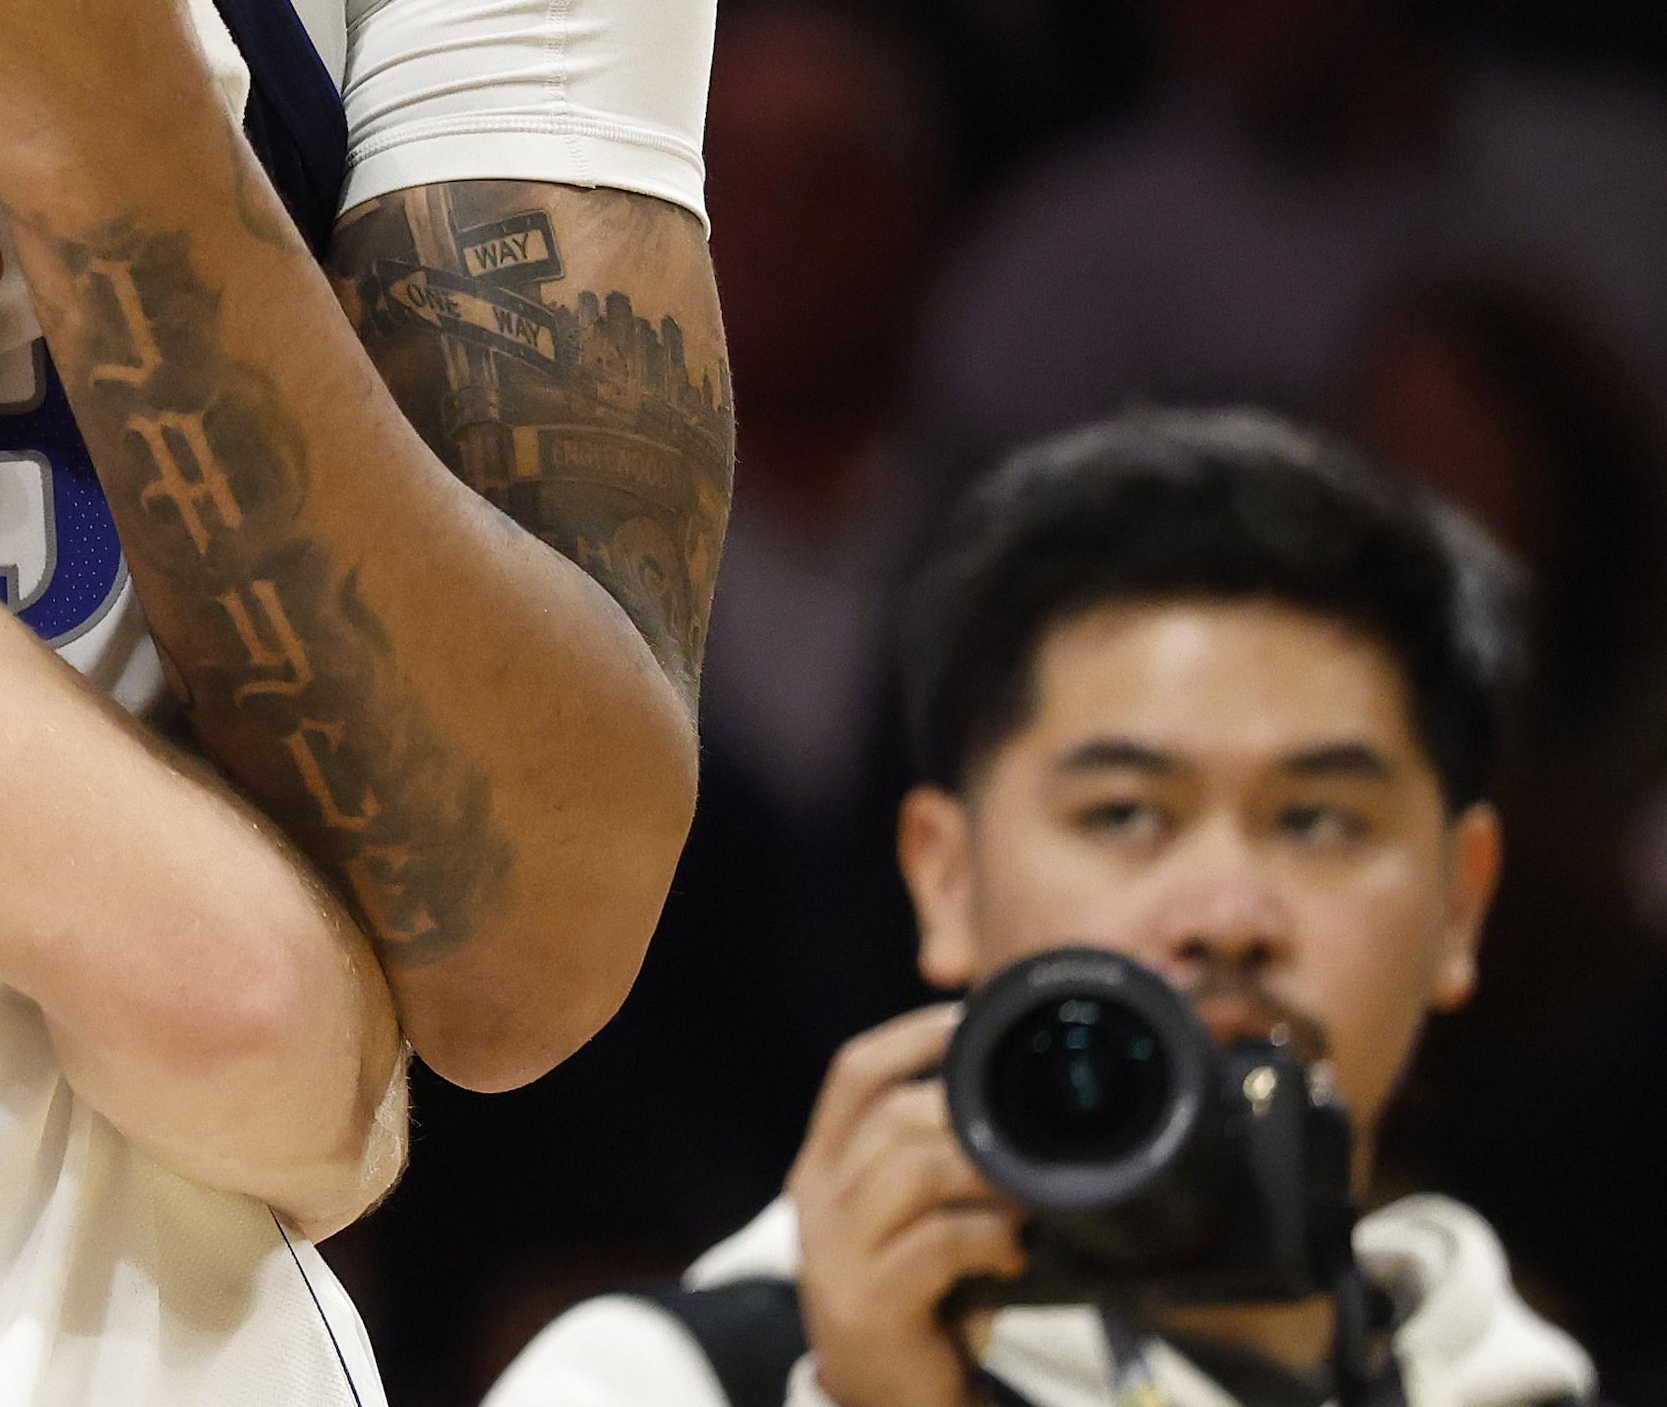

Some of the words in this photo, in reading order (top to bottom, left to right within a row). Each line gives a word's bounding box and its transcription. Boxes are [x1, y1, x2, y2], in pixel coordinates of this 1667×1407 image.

[475, 233, 529, 270] WAY
[407, 284, 462, 318] ONE
[492, 306, 541, 348] WAY
